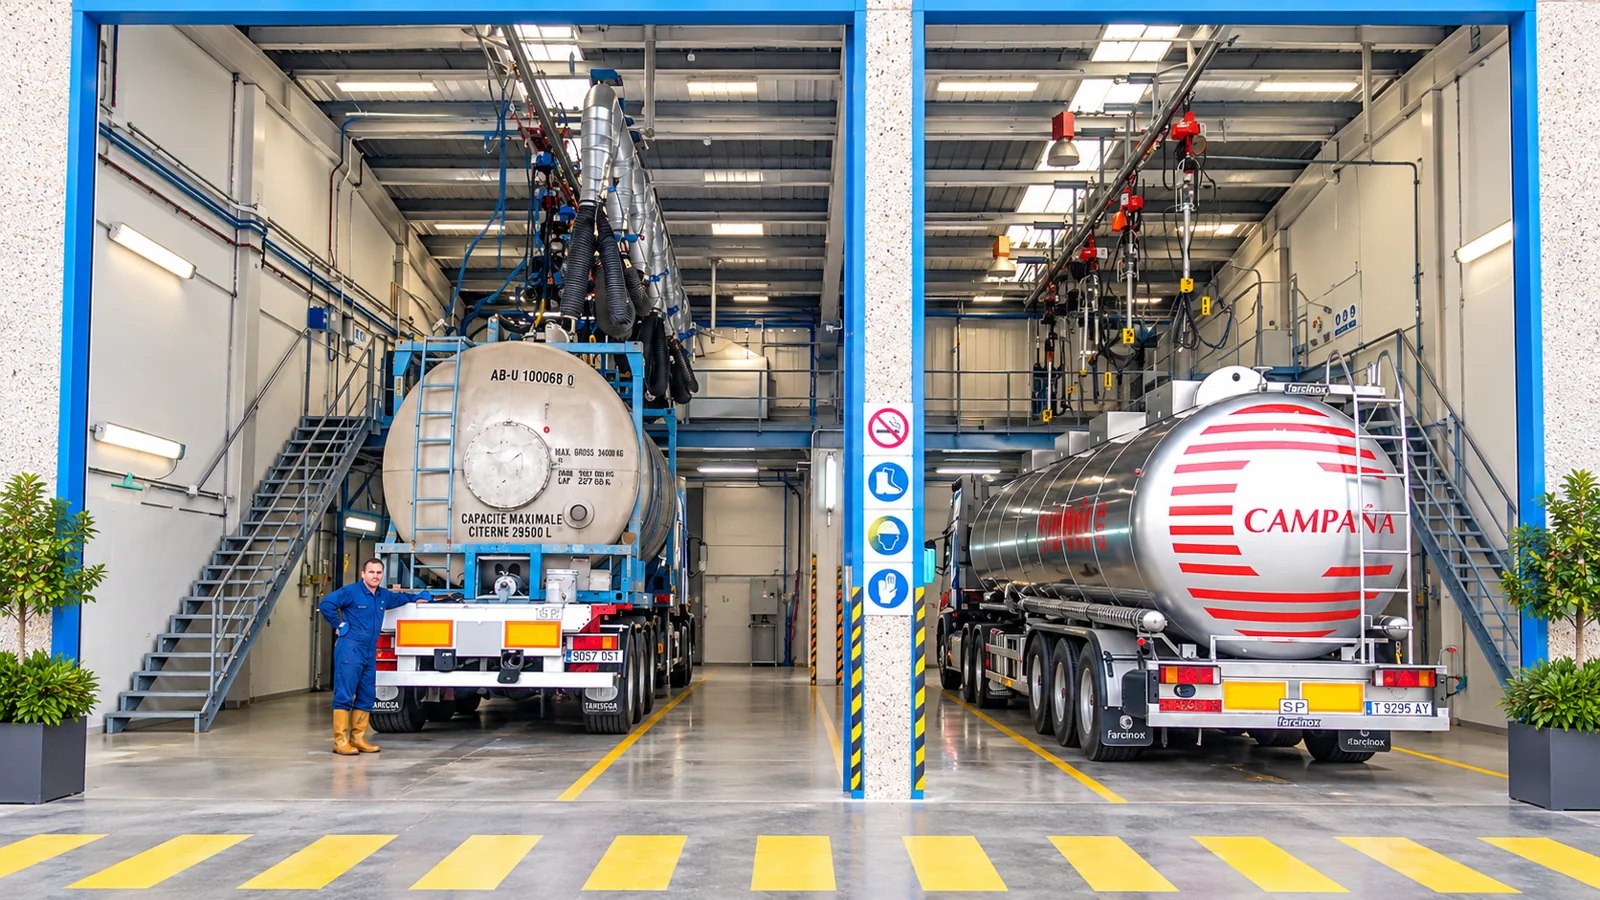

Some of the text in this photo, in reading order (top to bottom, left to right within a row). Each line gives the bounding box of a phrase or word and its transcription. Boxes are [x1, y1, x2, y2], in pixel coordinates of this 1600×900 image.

[491, 369, 519, 381] AB-U
[523, 370, 563, 385] 100068
[461, 513, 562, 525] CAPACITE MAXIMALE
[1244, 503, 1394, 534] CAMPAÑA
[468, 526, 552, 538] CITERNE 29500 L
[573, 651, 597, 661] 9057
[1283, 702, 1305, 713] SP
[1374, 703, 1430, 714] T 9295 AY
[1278, 716, 1321, 727] farcinox
[1107, 730, 1146, 739] farcinox
